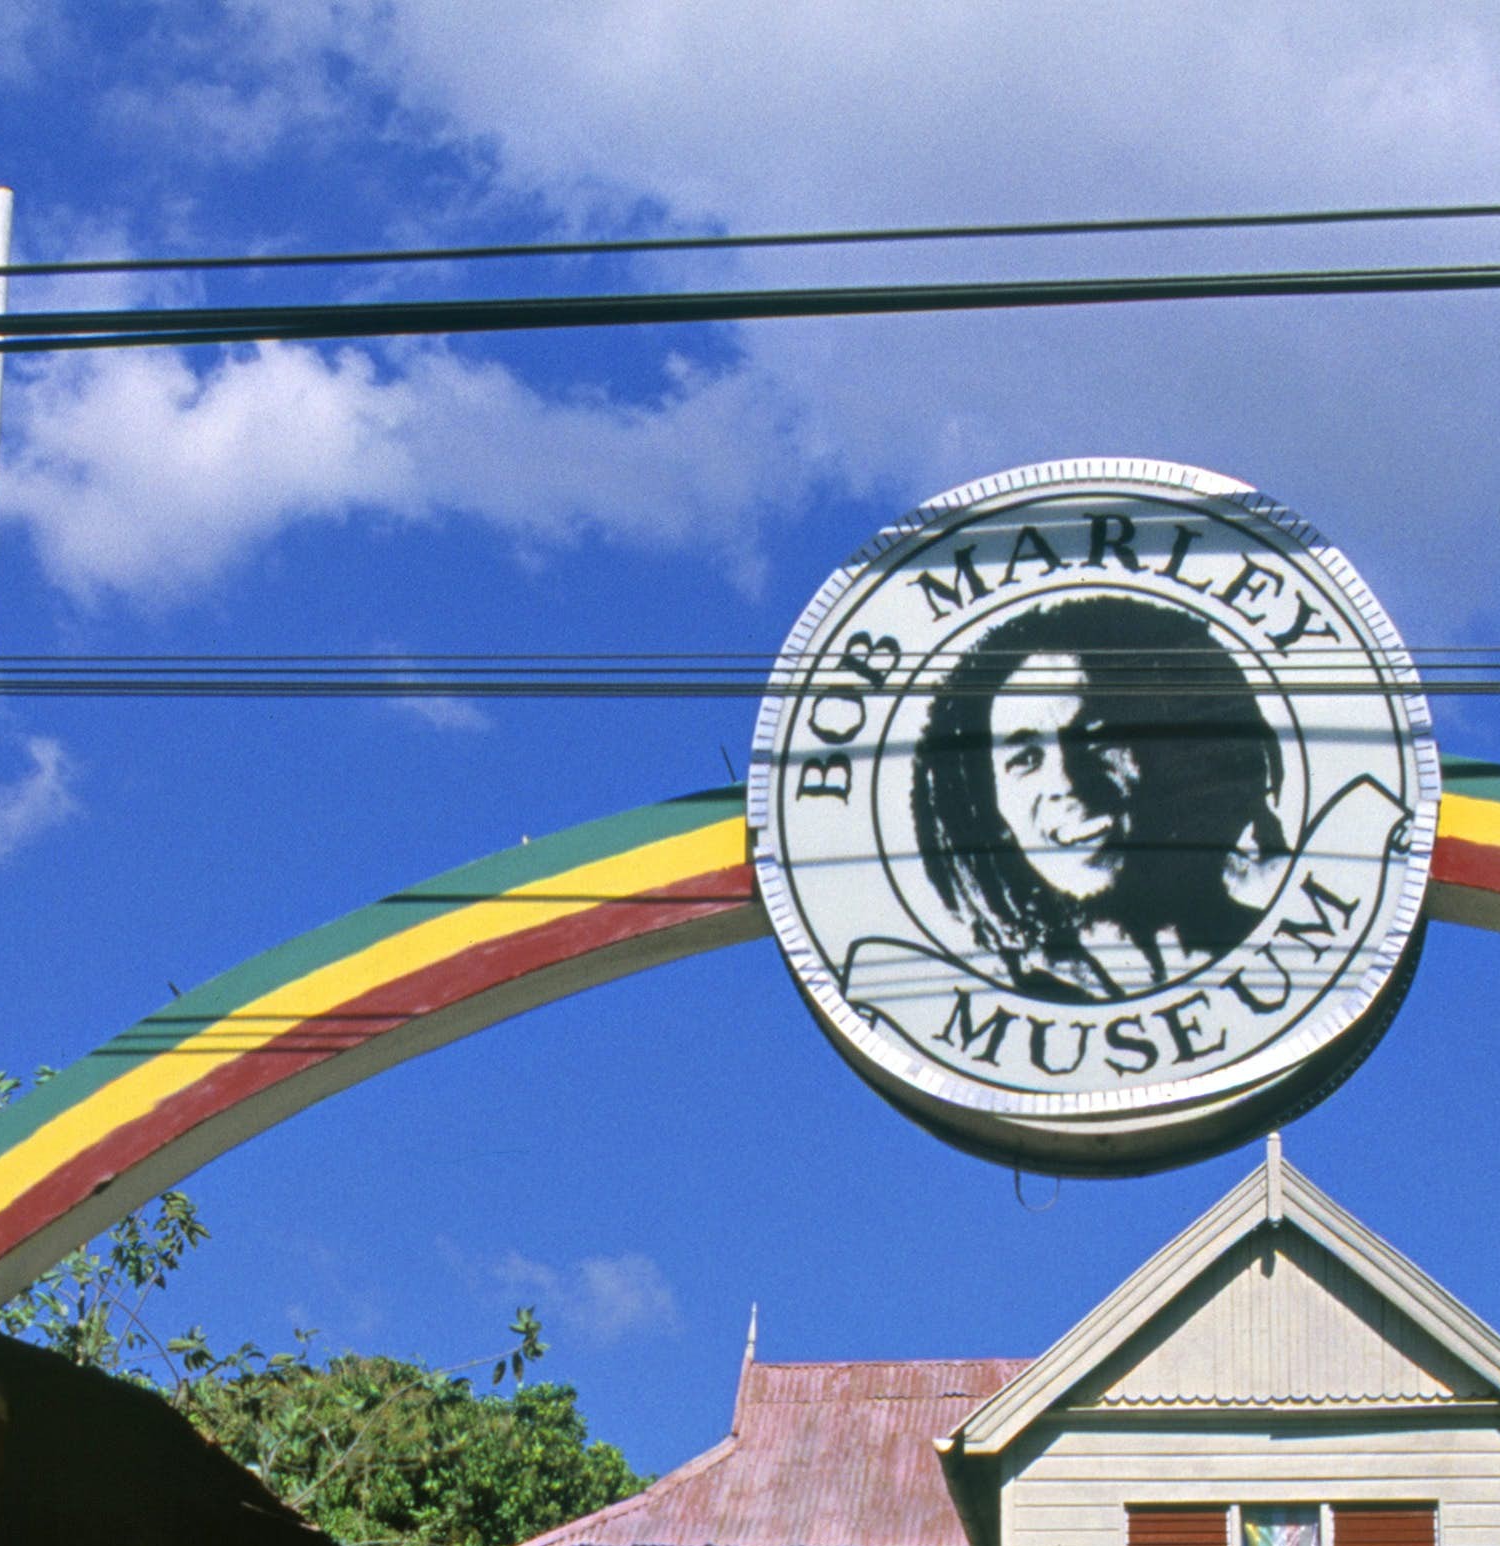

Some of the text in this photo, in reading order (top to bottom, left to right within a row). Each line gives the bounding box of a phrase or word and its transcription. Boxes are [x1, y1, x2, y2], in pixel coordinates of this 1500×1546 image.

[797, 513, 1342, 805] BOB MARLEY
[934, 872, 1360, 1077] MUSEUM
